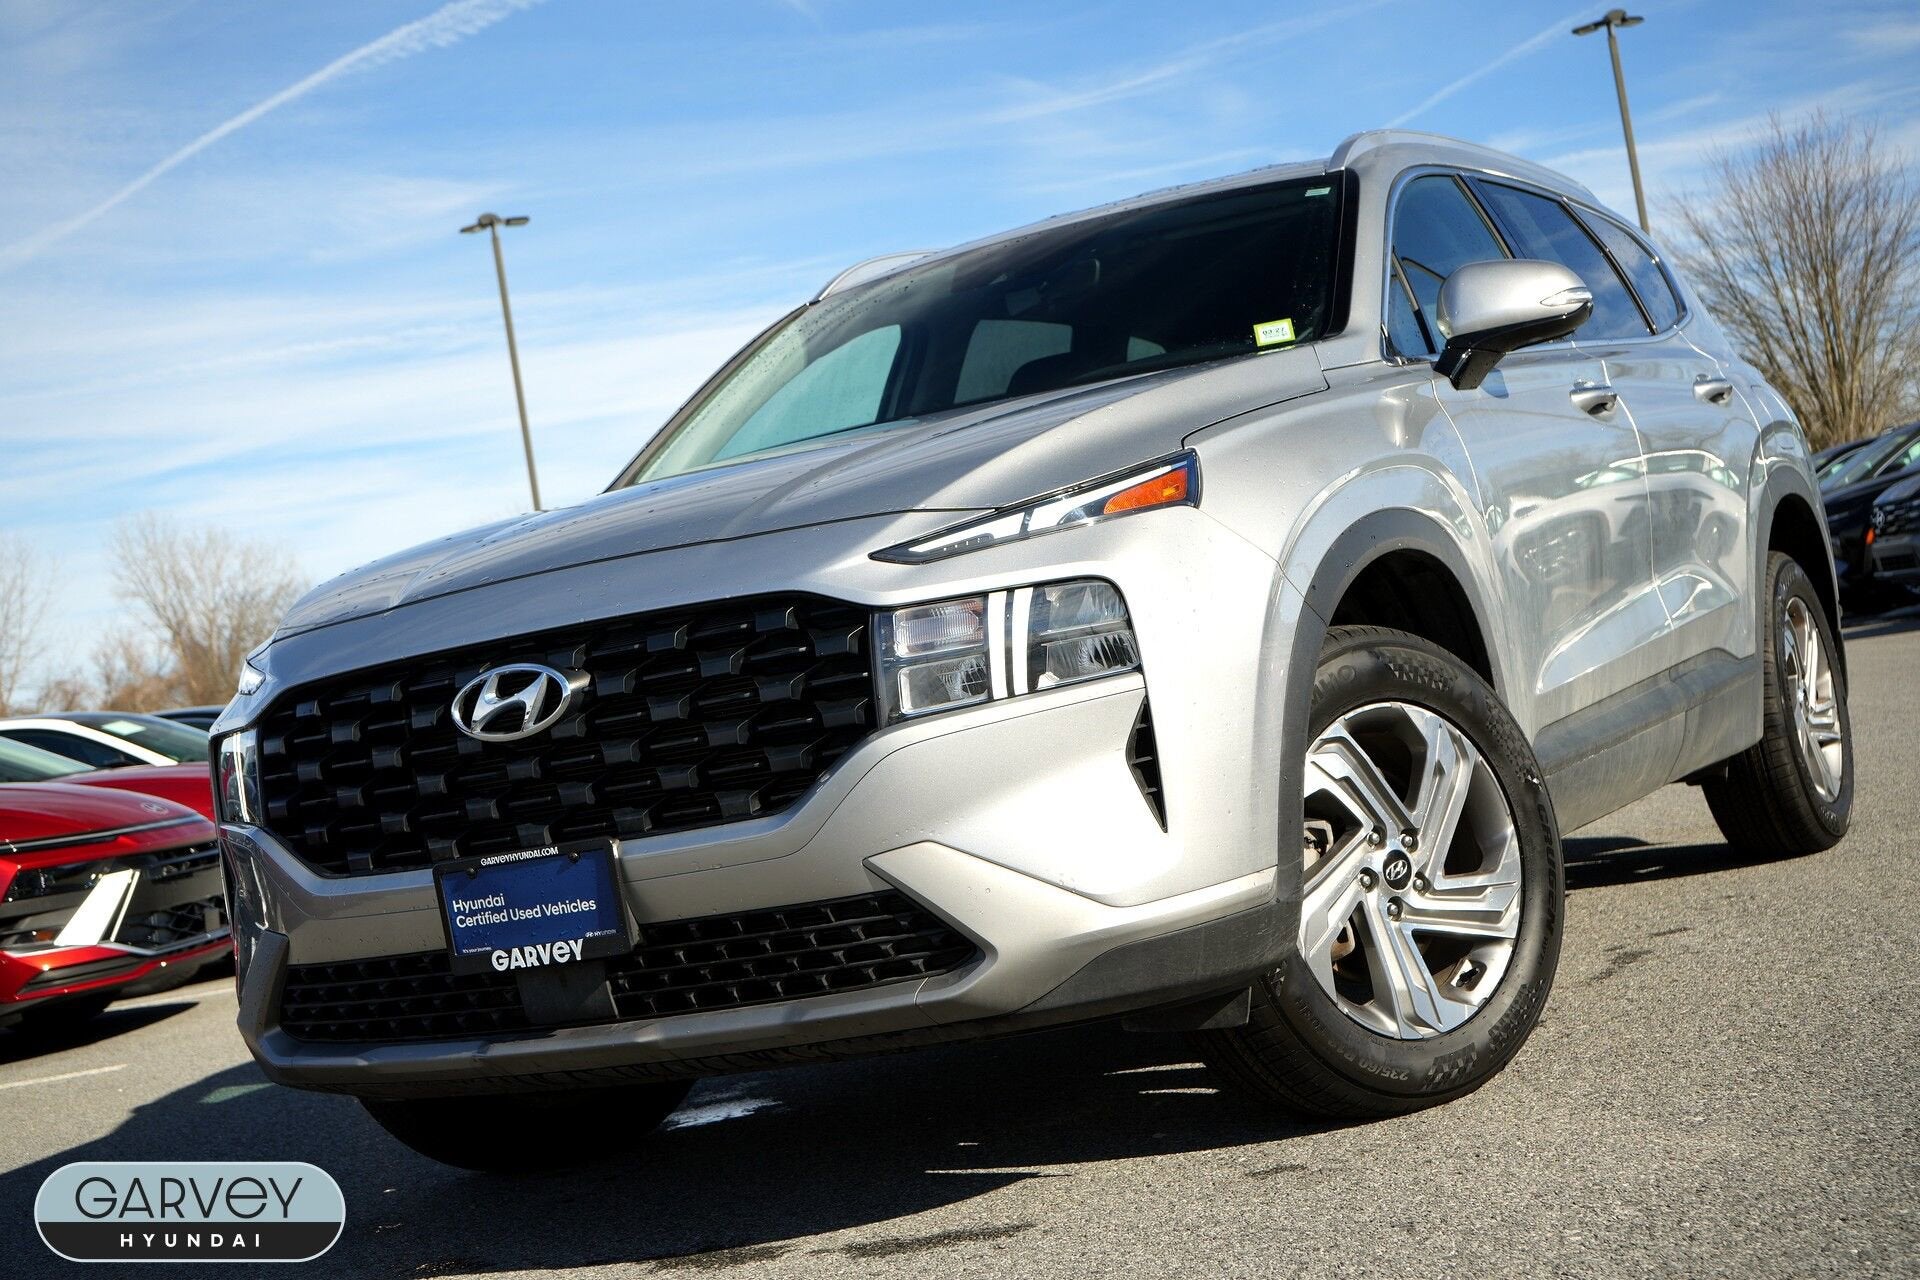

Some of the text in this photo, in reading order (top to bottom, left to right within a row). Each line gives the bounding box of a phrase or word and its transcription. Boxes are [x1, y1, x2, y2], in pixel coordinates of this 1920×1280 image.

[1537, 803, 1557, 937] CRUGEN
[452, 893, 505, 914] Hyundai
[456, 899, 597, 928] Certified Used Vehicles
